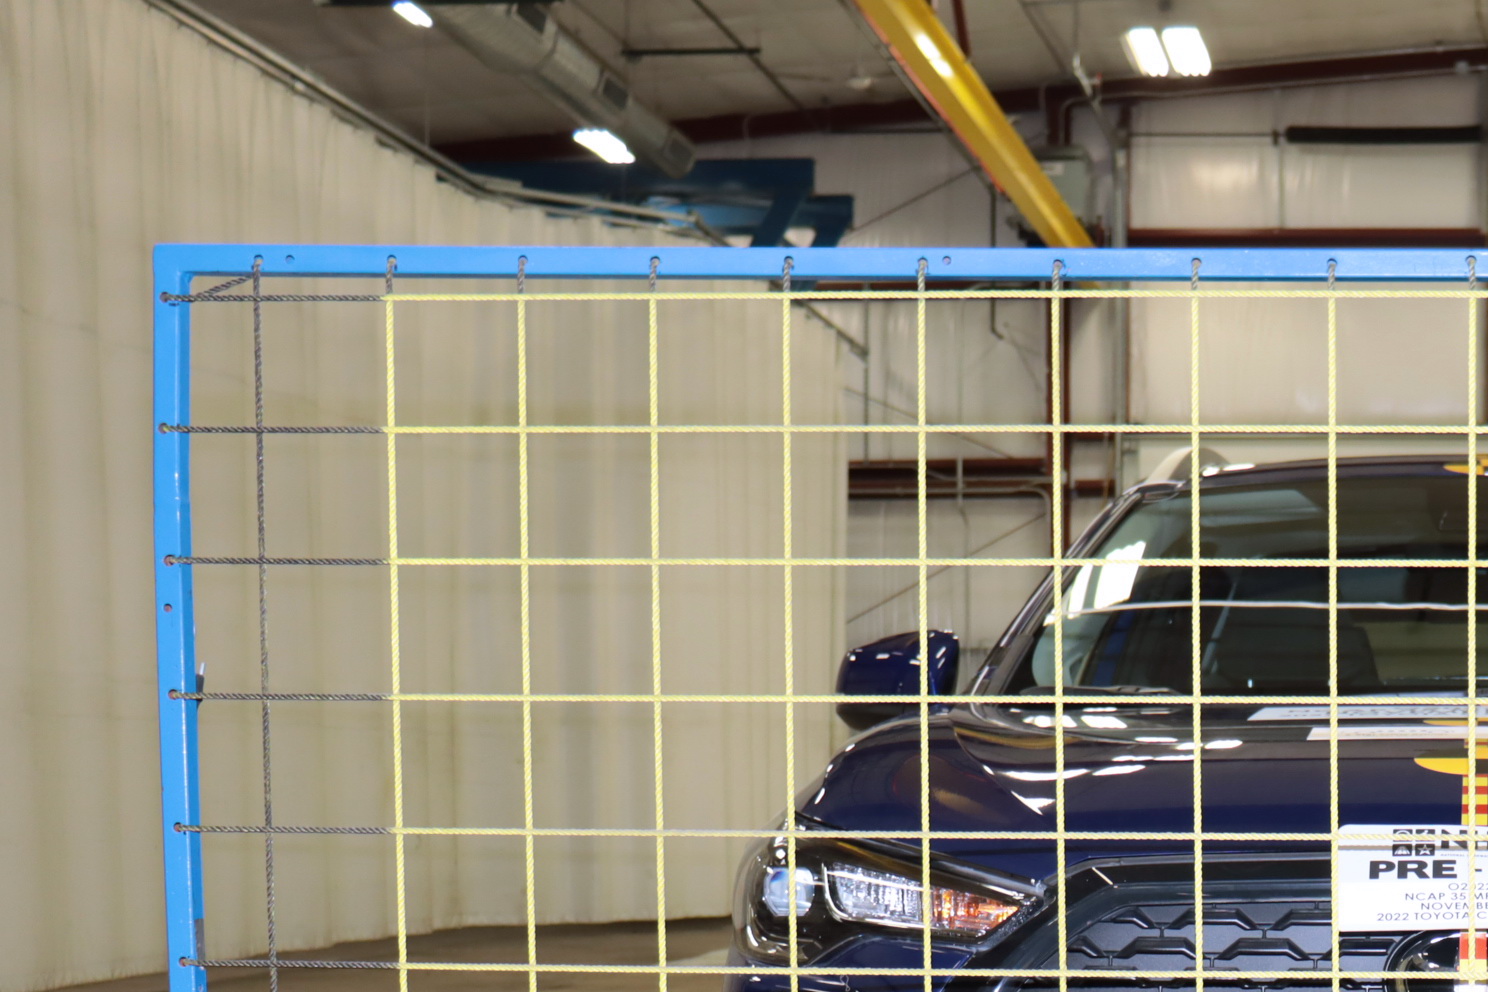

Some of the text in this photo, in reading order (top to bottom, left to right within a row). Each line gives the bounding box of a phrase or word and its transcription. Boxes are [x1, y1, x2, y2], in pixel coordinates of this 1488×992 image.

[1369, 860, 1457, 879] PRE
[1405, 892, 1445, 900] NCAP
[1451, 892, 1467, 900] 35
[1377, 912, 1409, 921] 2022
[1414, 911, 1470, 920] TOYOTA
